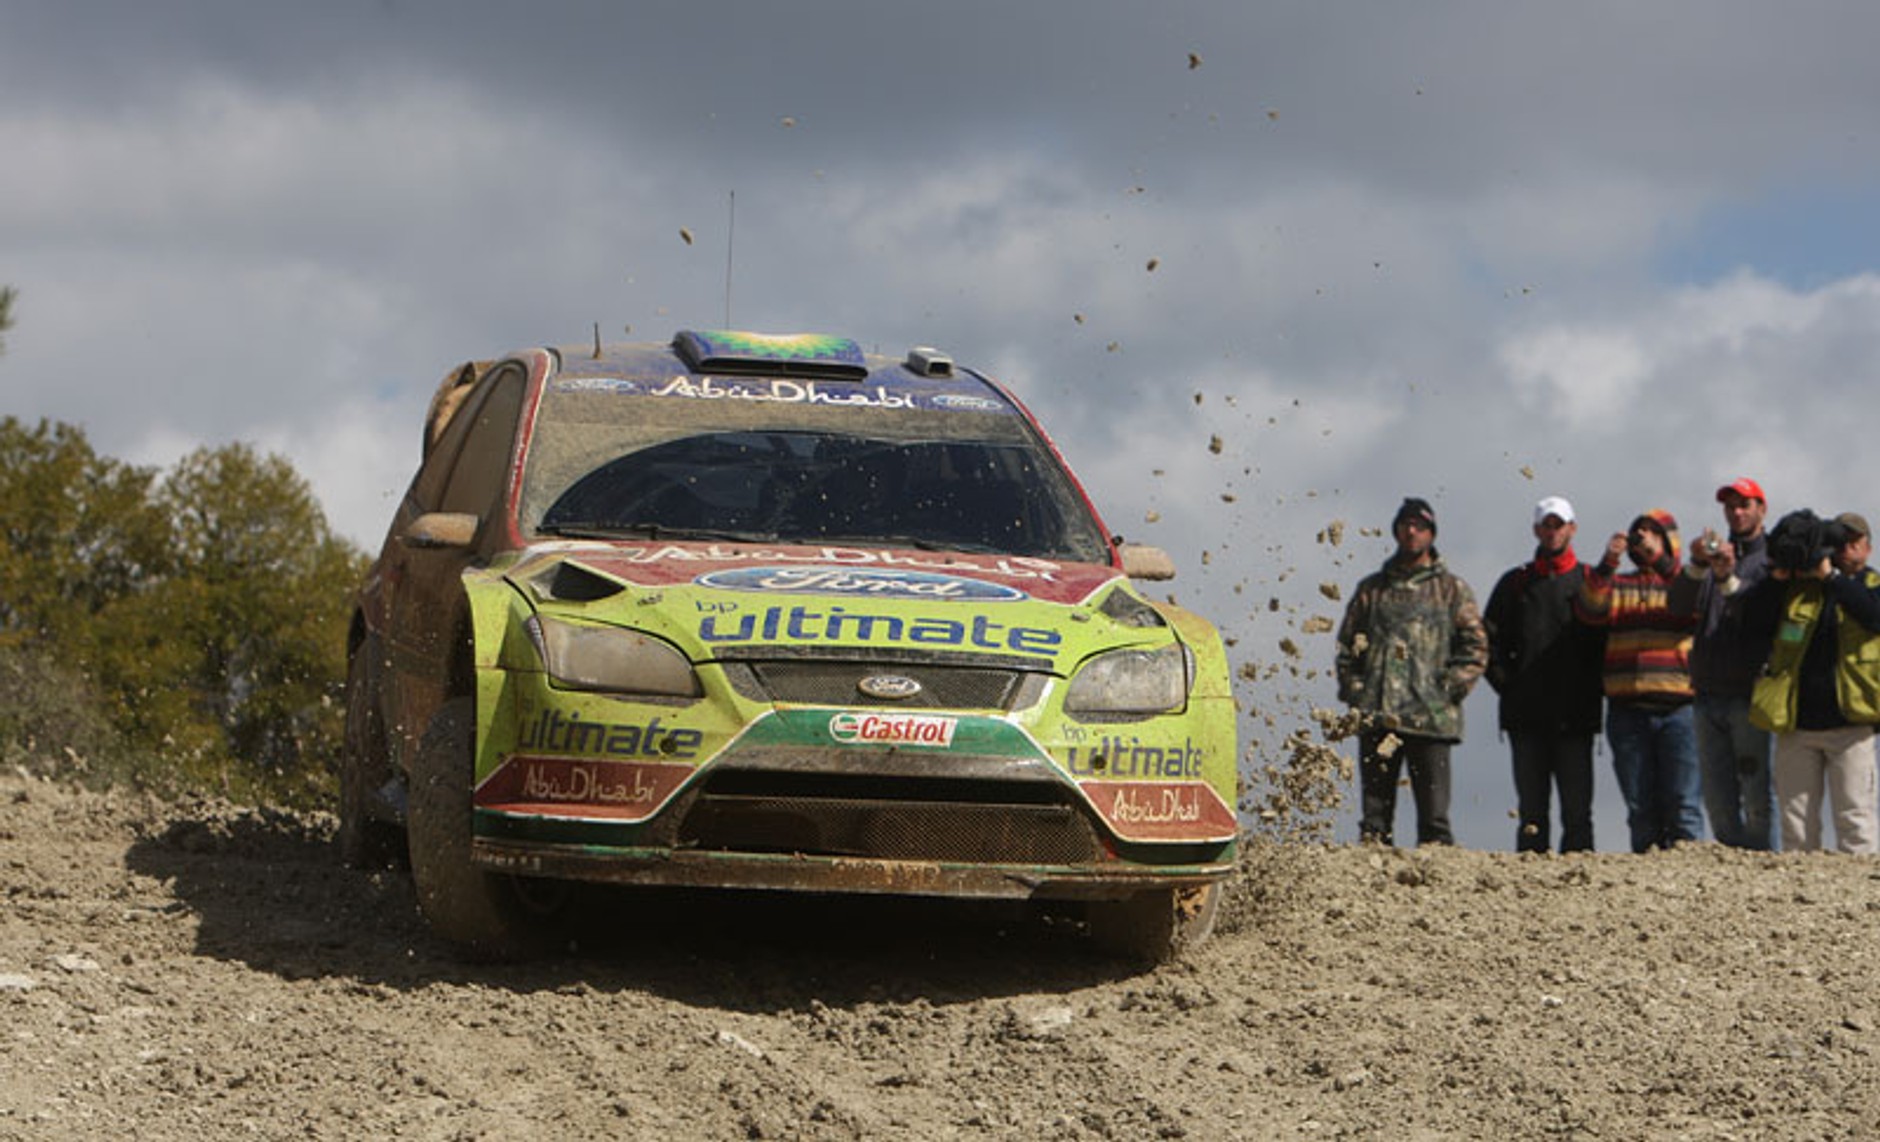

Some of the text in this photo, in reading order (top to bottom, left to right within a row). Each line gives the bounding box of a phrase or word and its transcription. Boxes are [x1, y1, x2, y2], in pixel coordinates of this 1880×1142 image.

[760, 570, 966, 597] Ford
[696, 600, 738, 613] bp
[701, 606, 1062, 656] ultimate
[518, 708, 704, 758] ultimate
[860, 716, 948, 743] Castrol
[1069, 735, 1204, 778] ultimate
